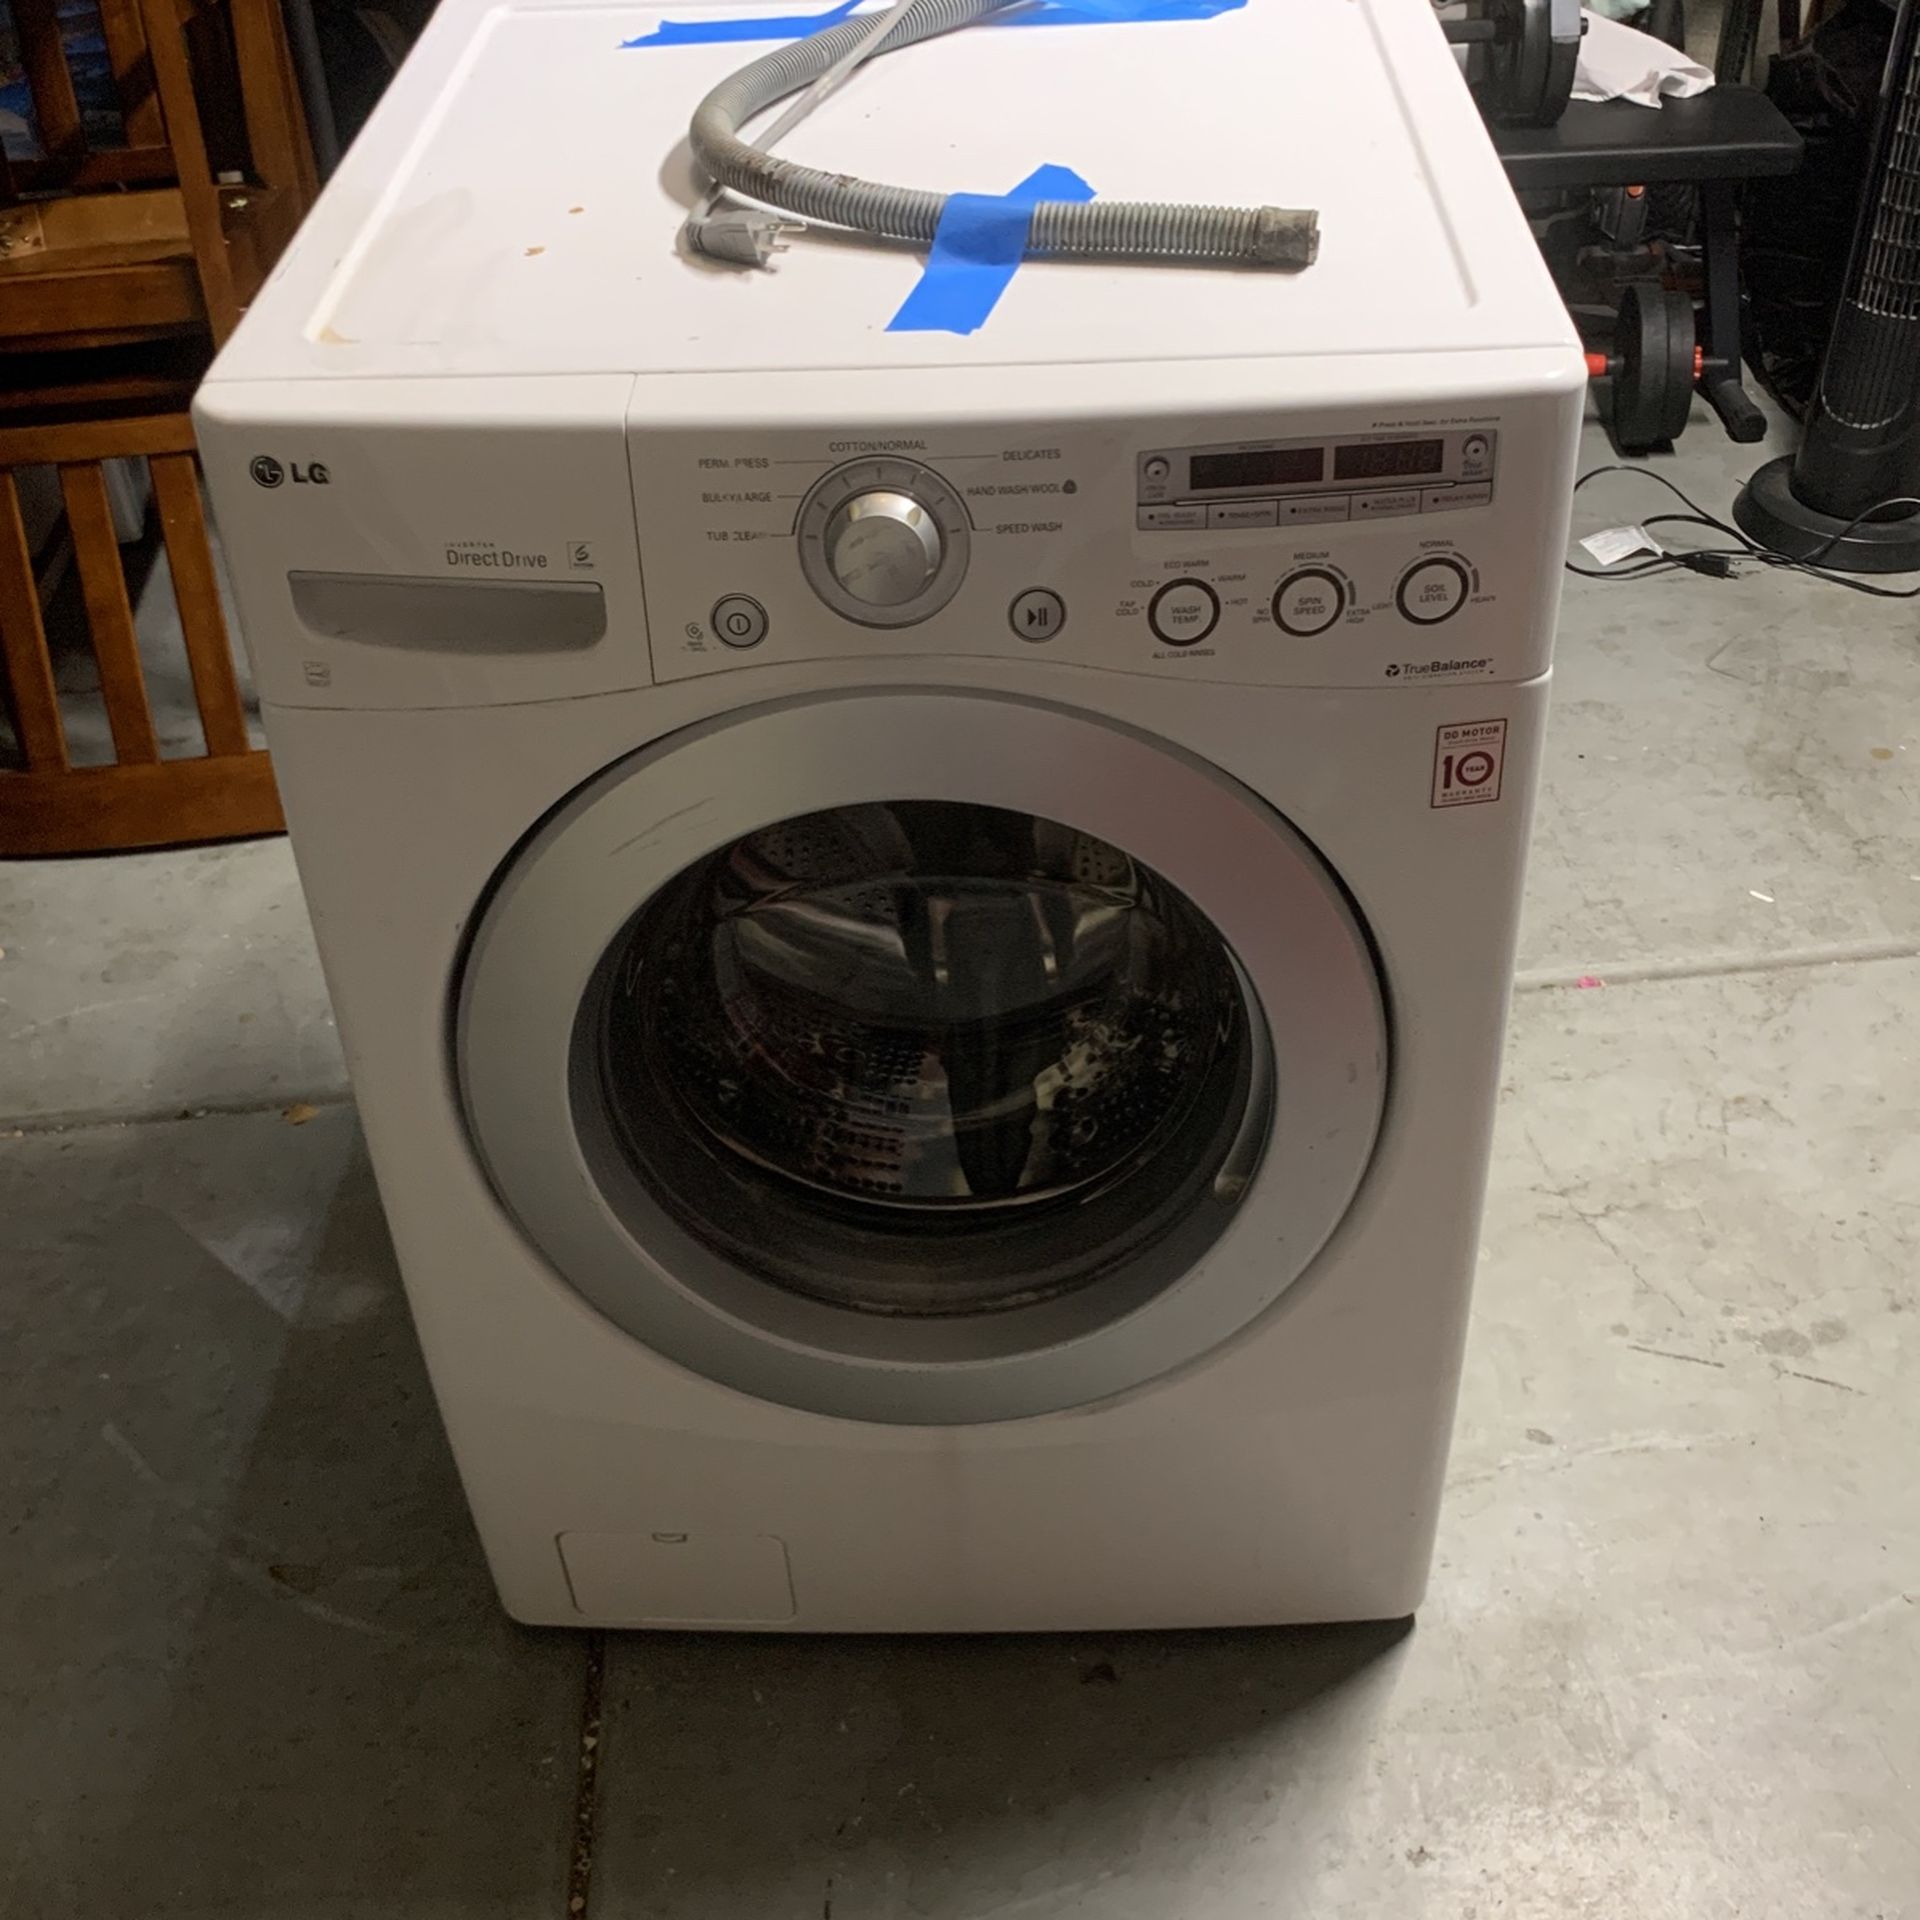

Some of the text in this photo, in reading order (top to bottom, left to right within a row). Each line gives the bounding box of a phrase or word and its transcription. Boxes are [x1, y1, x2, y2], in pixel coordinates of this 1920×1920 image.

[1003, 449, 1061, 461] DELICATES
[291, 462, 330, 484] LG
[996, 522, 1063, 534] SPEED WASH
[707, 531, 729, 541] TUB
[1419, 540, 1455, 548] NORMAL
[446, 549, 548, 568] Direct Drive
[1293, 552, 1330, 560] MEDIUM
[1130, 580, 1154, 588] COLD
[1419, 593, 1448, 603] LEVEL
[1115, 608, 1139, 616] COLD
[1171, 606, 1201, 614] WASH
[1293, 605, 1325, 615] SPEED
[1462, 726, 1500, 738] MOTOR
[1443, 750, 1495, 789] 10
